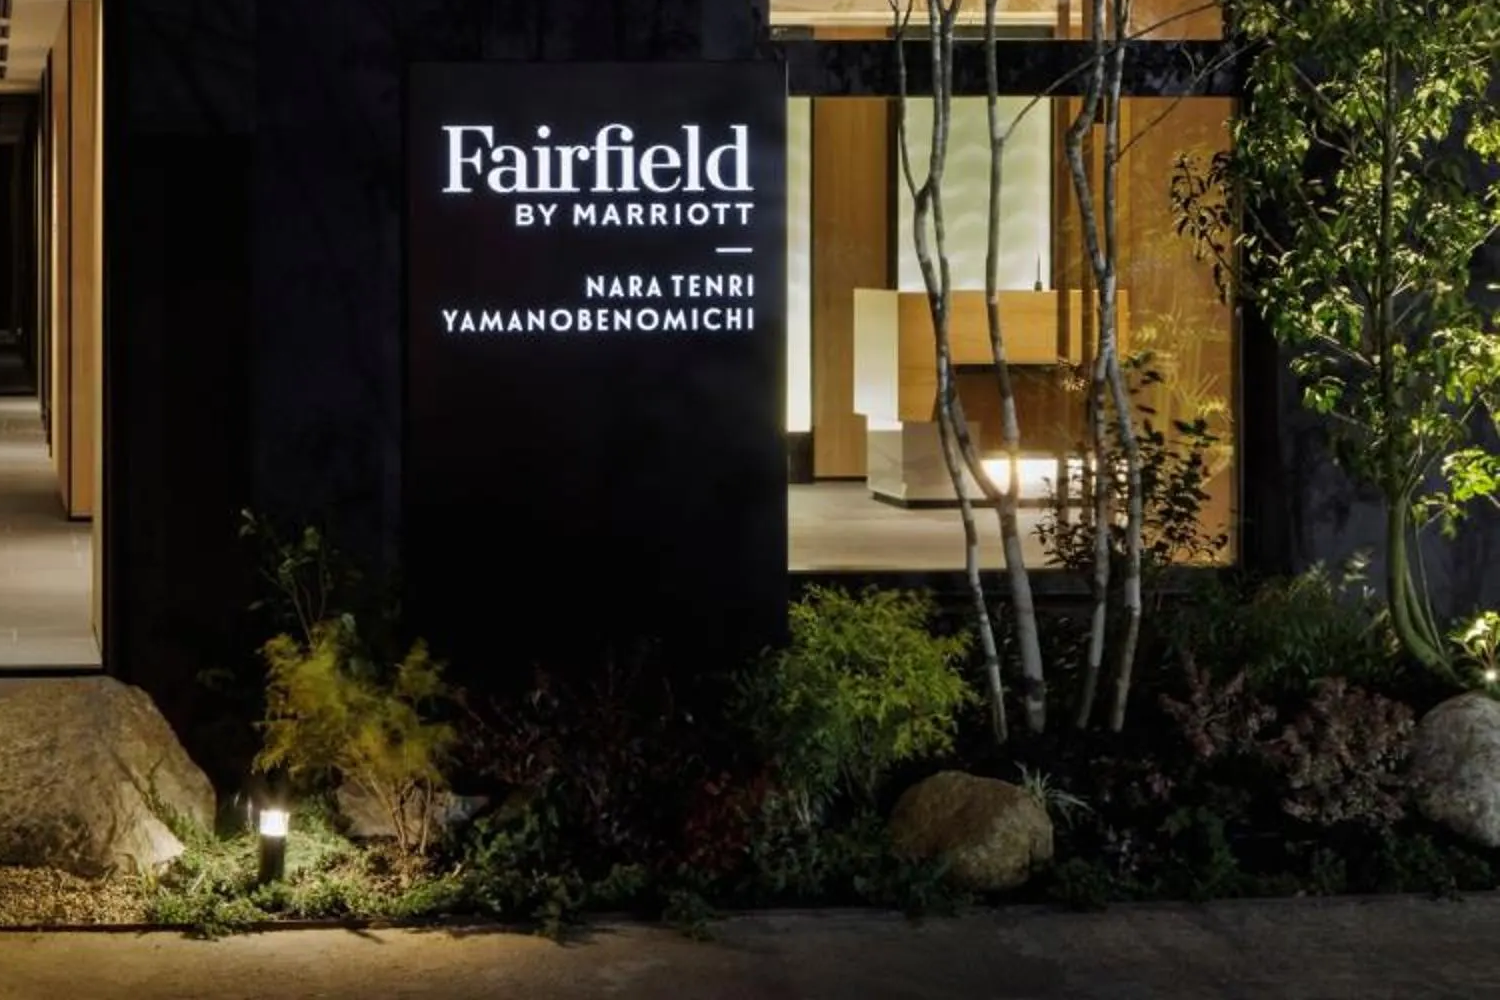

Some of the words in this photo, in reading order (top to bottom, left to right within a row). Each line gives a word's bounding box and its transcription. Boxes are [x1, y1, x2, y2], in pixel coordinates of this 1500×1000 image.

[442, 124, 755, 193] Fairfield
[516, 203, 558, 226] BY
[573, 202, 755, 226] MARRIOTT
[586, 275, 663, 298] NARA
[670, 274, 755, 297] TENRI
[442, 308, 755, 333] YAMANOBENOMICHI
